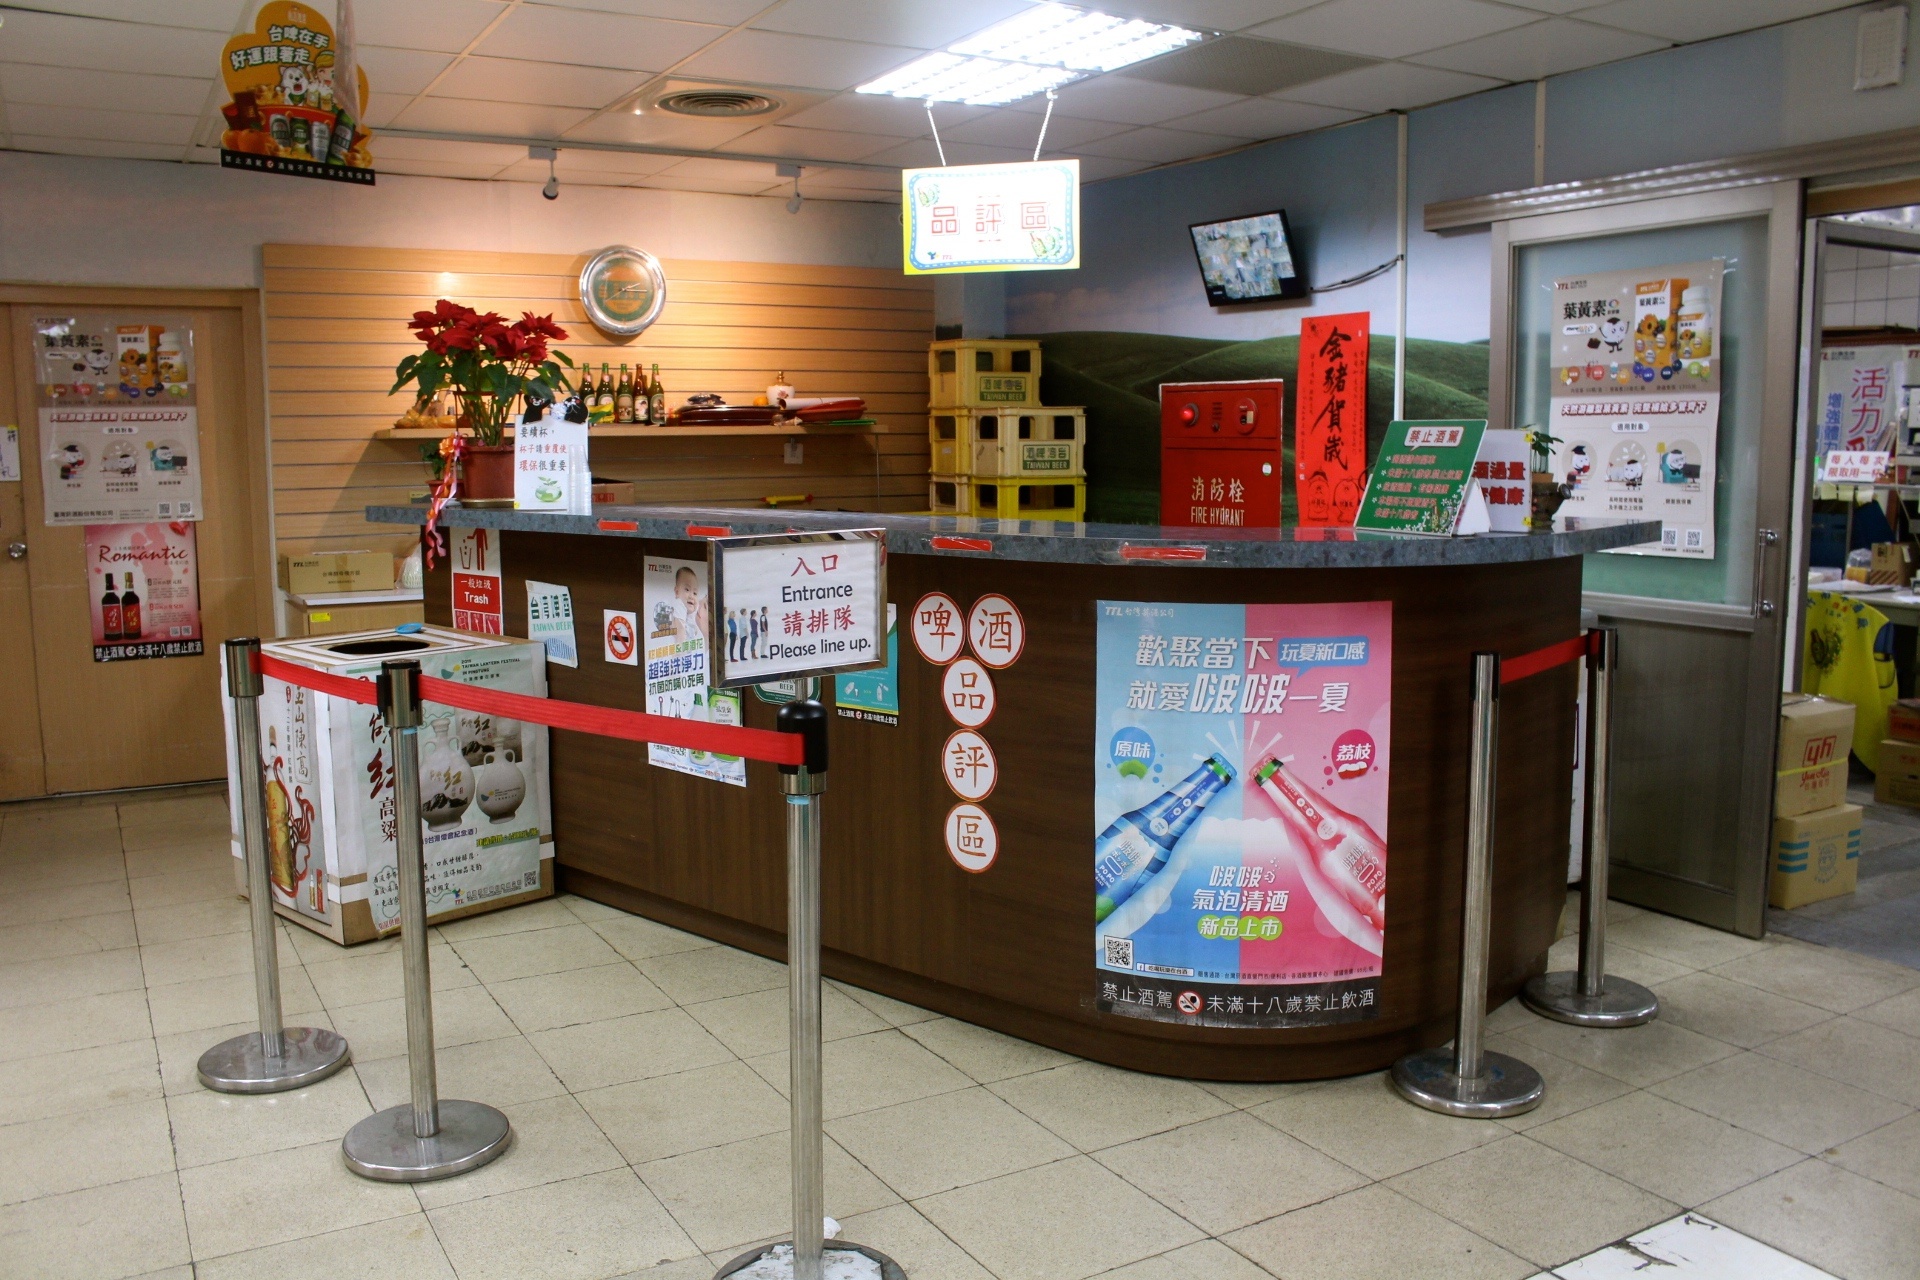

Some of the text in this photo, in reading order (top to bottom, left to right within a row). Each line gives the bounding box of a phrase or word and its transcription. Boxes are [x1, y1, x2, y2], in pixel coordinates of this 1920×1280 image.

[268, 24, 330, 48] 台啤在手
[931, 201, 1047, 235] 品評區
[1563, 300, 1606, 320] 葉黃素
[983, 391, 1024, 400] TAIWAN BEER
[1409, 430, 1460, 443] 禁止酒駕
[519, 459, 567, 472] 環保很重要
[1026, 459, 1068, 469] TAIWAN BEER
[1191, 477, 1245, 503] 消防栓
[1191, 506, 1244, 526] FIRE HYDRANT
[99, 545, 188, 563] Romantic
[648, 563, 658, 572] TTL
[791, 554, 839, 577] 入口
[461, 578, 491, 590] 一般垃圾
[782, 584, 853, 603] Entrance
[464, 592, 489, 605] Trash
[782, 605, 855, 637] 請排隊
[1105, 607, 1123, 616] TTL
[555, 621, 572, 631] BEER
[95, 647, 125, 659] 禁止酒駕
[769, 637, 871, 660] Please line up.
[1135, 634, 1273, 669] 歡聚當下
[1281, 641, 1366, 662] 玩夏新口感
[648, 653, 704, 680] 超強洗淨力
[779, 683, 794, 691] BEER
[1126, 673, 1350, 714] 就愛啵啵一夏
[1114, 741, 1151, 759] 原味
[1336, 743, 1371, 761] 荔枝
[1208, 865, 1263, 888] 啵啵
[1192, 888, 1289, 913] 氣泡清酒
[1200, 919, 1280, 938] 新品上市
[1102, 982, 1375, 1015] 禁止酒駕 未滿十八歲禁止飲酒
